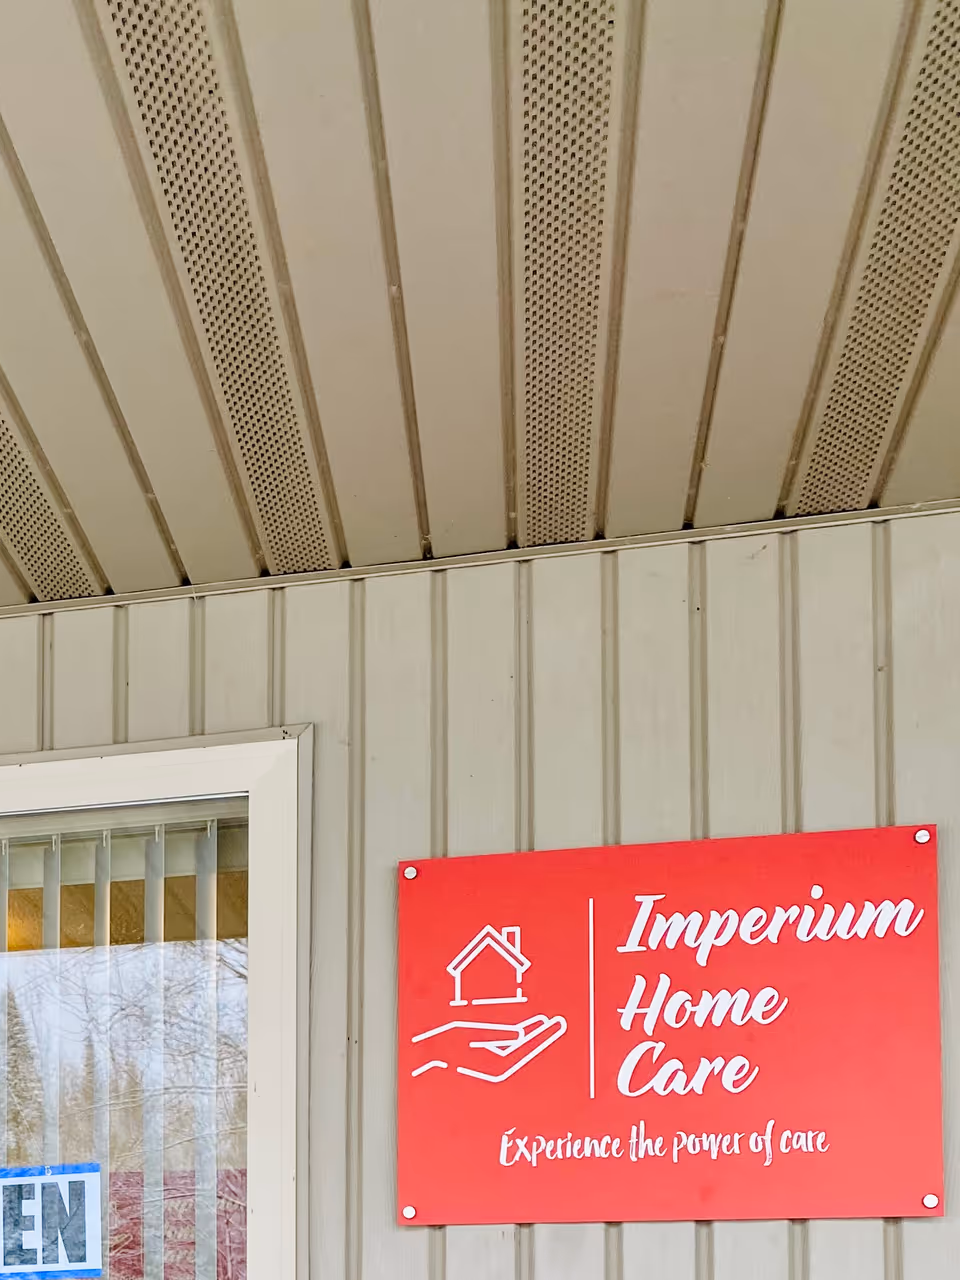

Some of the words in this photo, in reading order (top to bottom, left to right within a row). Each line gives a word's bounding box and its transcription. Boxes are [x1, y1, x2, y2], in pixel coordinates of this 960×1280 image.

[616, 884, 925, 967] Imperium
[616, 973, 790, 1037] Home
[616, 1040, 760, 1098] Care
[498, 1126, 625, 1168] Experience
[628, 1119, 668, 1163] the
[672, 1130, 746, 1164] power
[748, 1118, 776, 1168] of
[779, 1129, 831, 1155] care
